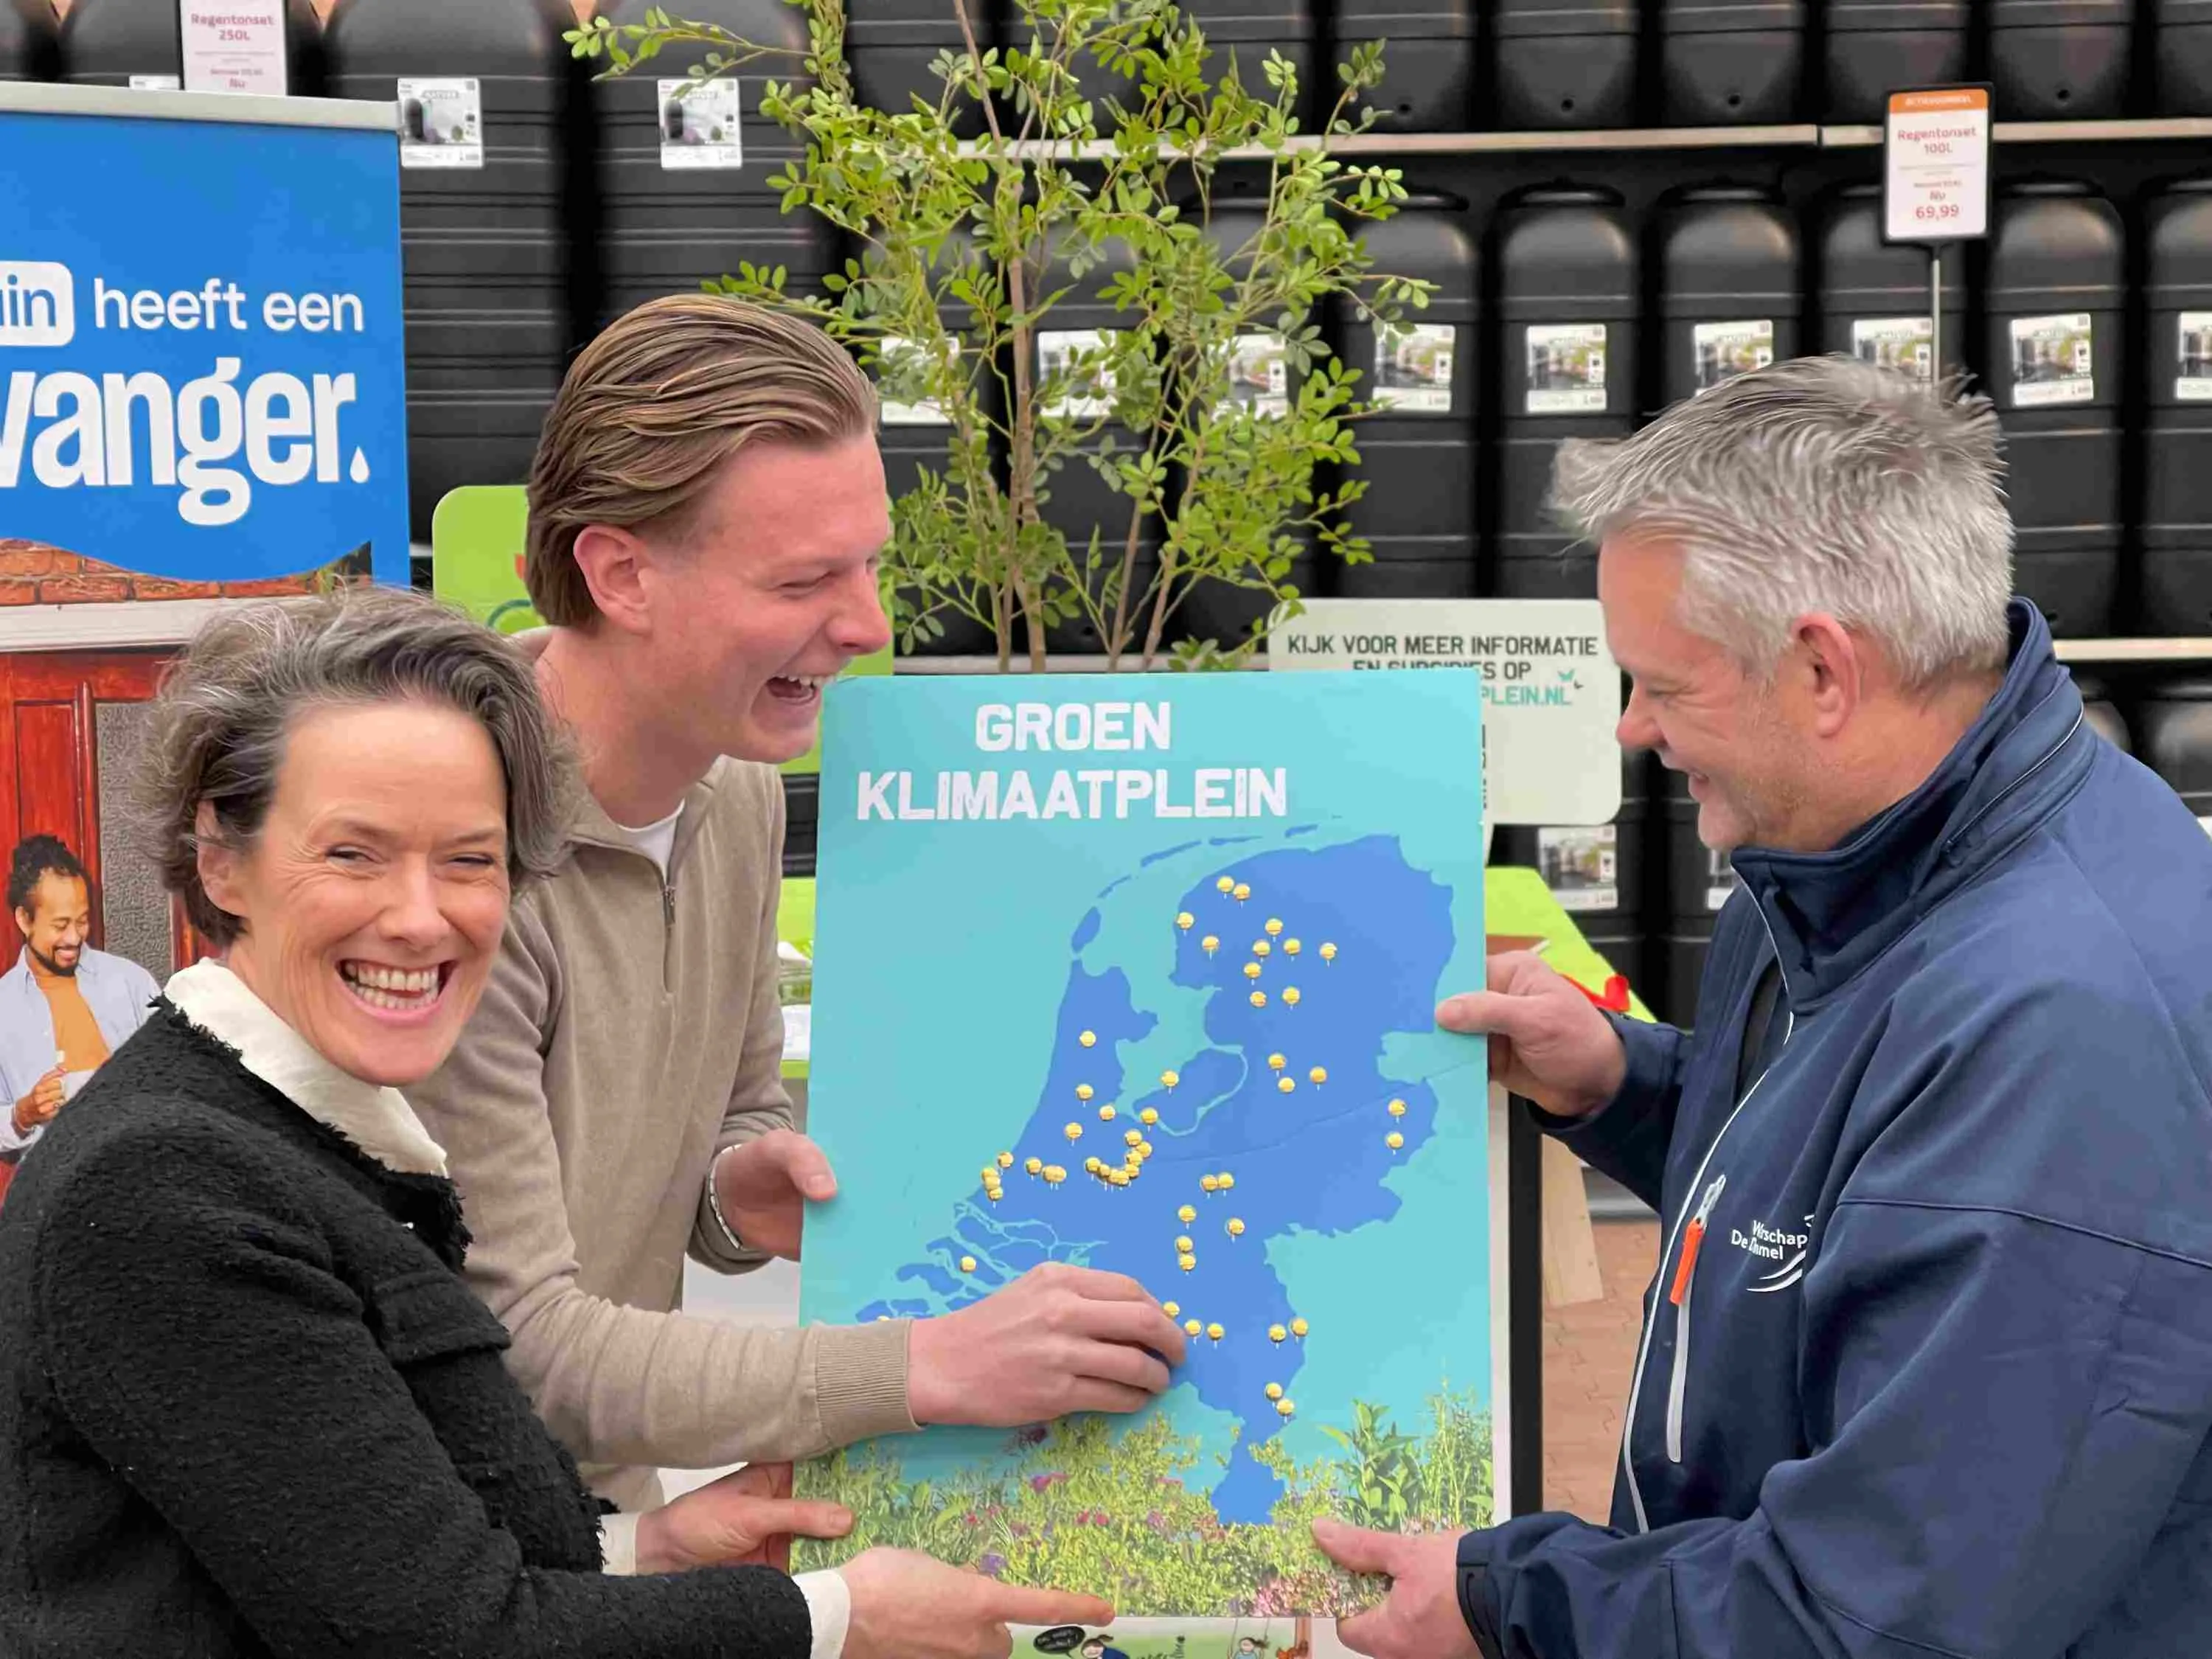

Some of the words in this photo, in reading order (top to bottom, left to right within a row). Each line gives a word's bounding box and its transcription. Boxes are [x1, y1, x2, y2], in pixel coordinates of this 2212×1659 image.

[191, 13, 274, 28] Regentonset
[1897, 127, 1977, 142] Regentonset
[1930, 191, 1946, 201] Nu
[1916, 205, 1960, 221] 69,99
[0, 274, 57, 327] in
[94, 277, 248, 330] heeft
[262, 292, 364, 332] een
[1288, 635, 1335, 655] KIJK
[1343, 635, 1397, 655] VOOR
[1405, 636, 1464, 655] MEER
[1471, 636, 1599, 656] INFORMATIE
[1504, 661, 1532, 680] OP
[975, 701, 1172, 752] GROEN
[856, 767, 1287, 821] KLIMAATPLEIN
[1731, 1228, 1748, 1248] De
